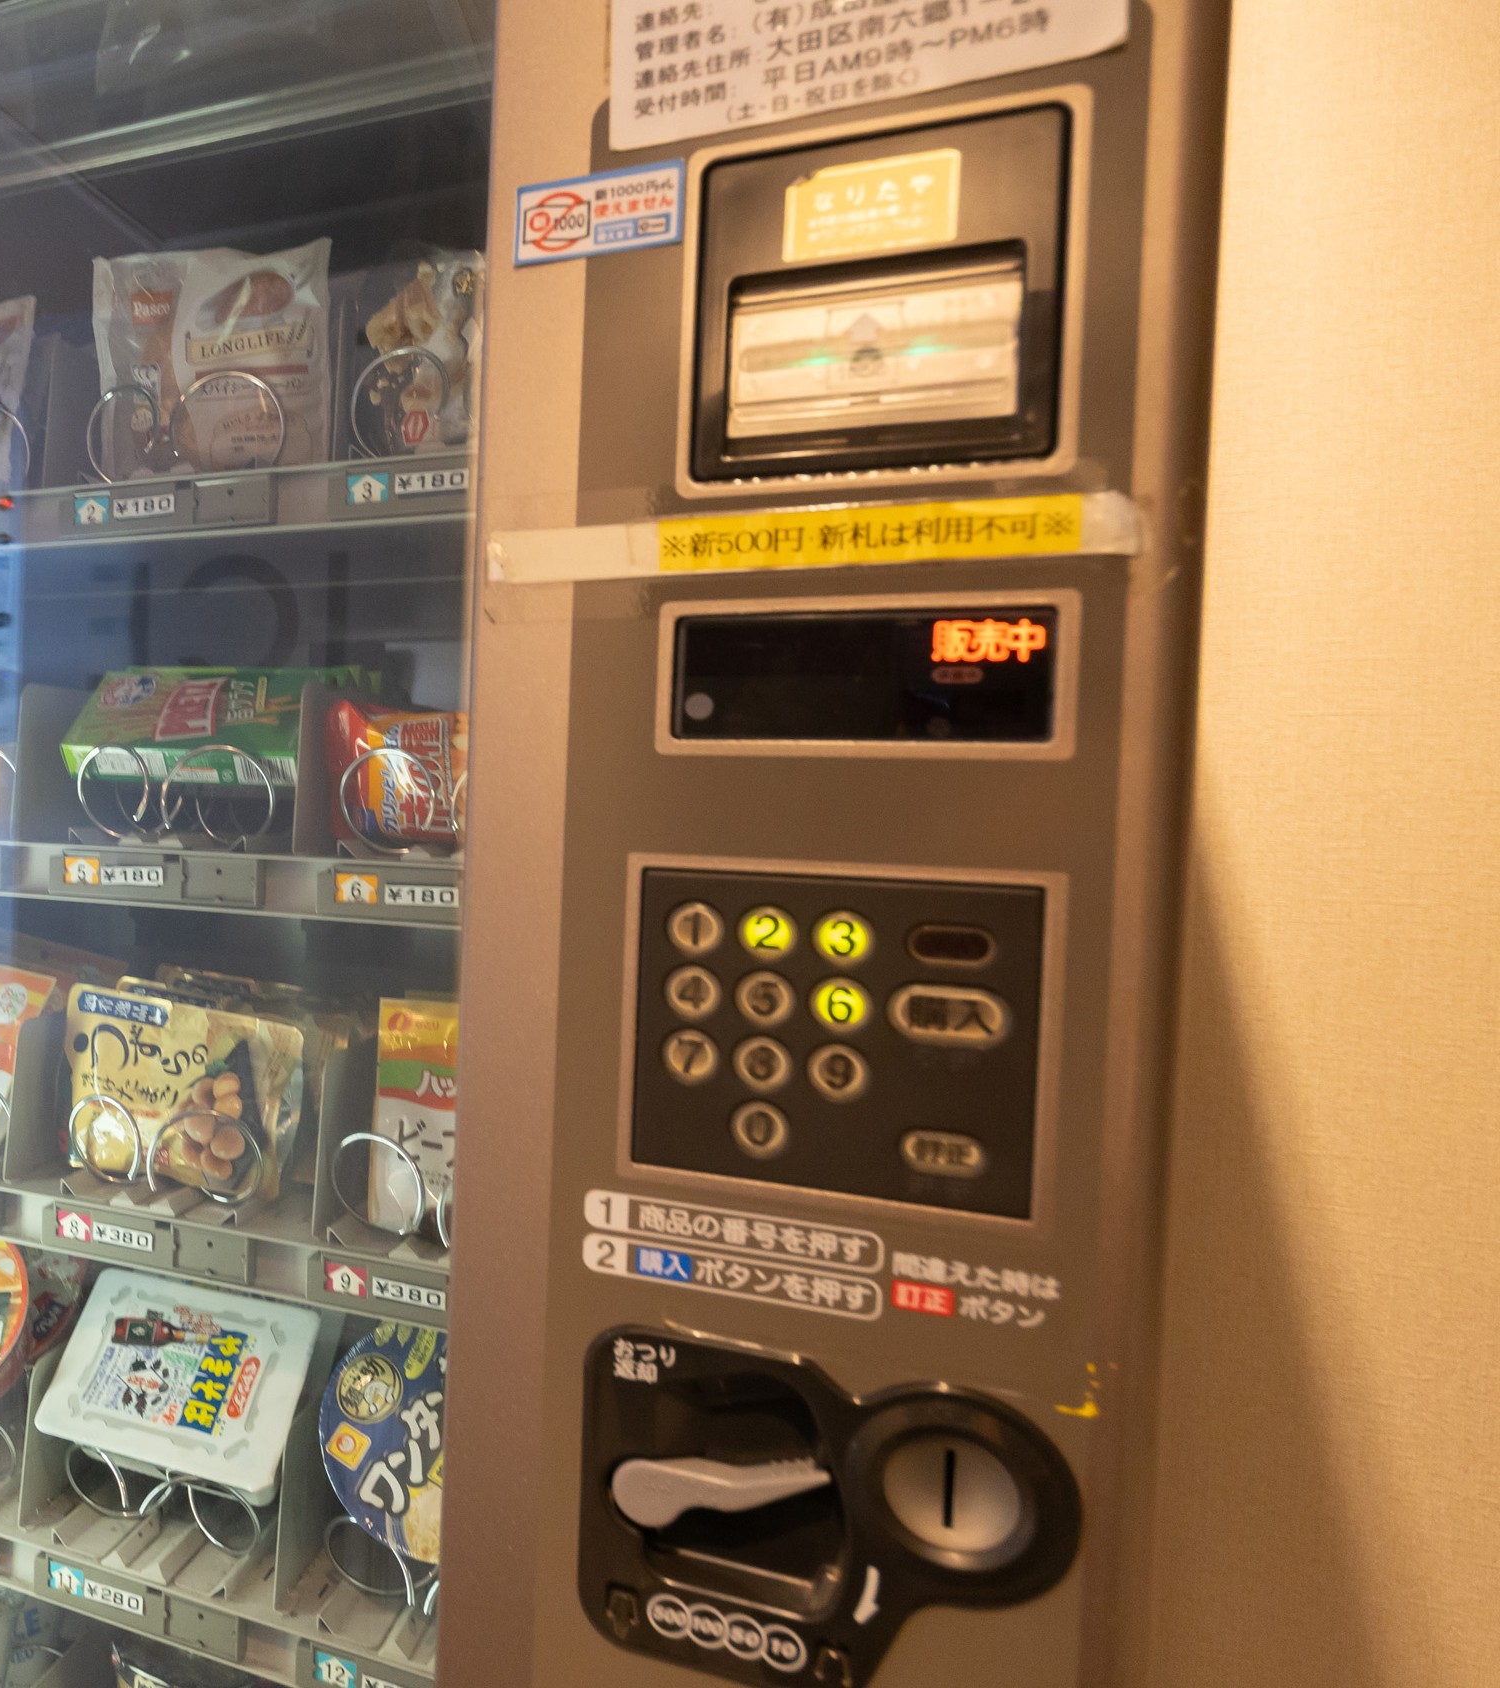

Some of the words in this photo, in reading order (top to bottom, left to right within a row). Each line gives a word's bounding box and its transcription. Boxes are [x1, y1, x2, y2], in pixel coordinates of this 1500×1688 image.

[132, 300, 171, 318] Pasco
[361, 481, 373, 501] 3
[397, 472, 465, 490] ¥180
[85, 503, 96, 522] 2
[114, 498, 170, 515] ¥180
[931, 619, 1047, 663] 販売中
[77, 863, 86, 882] 5
[104, 869, 160, 883] ¥180
[350, 881, 362, 901] 6
[388, 887, 455, 903] ¥180
[683, 912, 701, 946] 1
[753, 914, 781, 950] 2
[829, 919, 856, 956] 3
[678, 975, 702, 1009] 4
[749, 982, 776, 1016] 5
[827, 987, 853, 1024] 6
[908, 994, 995, 1036] 購入
[677, 1038, 707, 1074] 7
[749, 1046, 773, 1080] 8
[827, 1052, 851, 1089] 9
[748, 1110, 771, 1144] 0
[70, 1219, 79, 1237] 8
[96, 1225, 149, 1247] ¥380
[600, 1197, 613, 1226] 1
[638, 1204, 869, 1263] 商品の番号を押す
[340, 1272, 351, 1290] 9
[376, 1280, 442, 1306] ¥380
[596, 1239, 616, 1270] 2
[638, 1248, 690, 1280] 購入
[695, 1255, 872, 1311] ボタンを押す
[892, 1250, 1062, 1300] 間違えた時は
[895, 1284, 951, 1315] 訂正
[958, 1296, 1047, 1329] ボタン
[613, 1337, 677, 1369] おつり
[183, 1334, 244, 1429] やきそば
[359, 1390, 445, 1515] ワンタ
[57, 1573, 74, 1593] 11
[87, 1582, 140, 1611] ¥280
[771, 1640, 797, 1660] 10
[326, 1663, 346, 1684] 12
